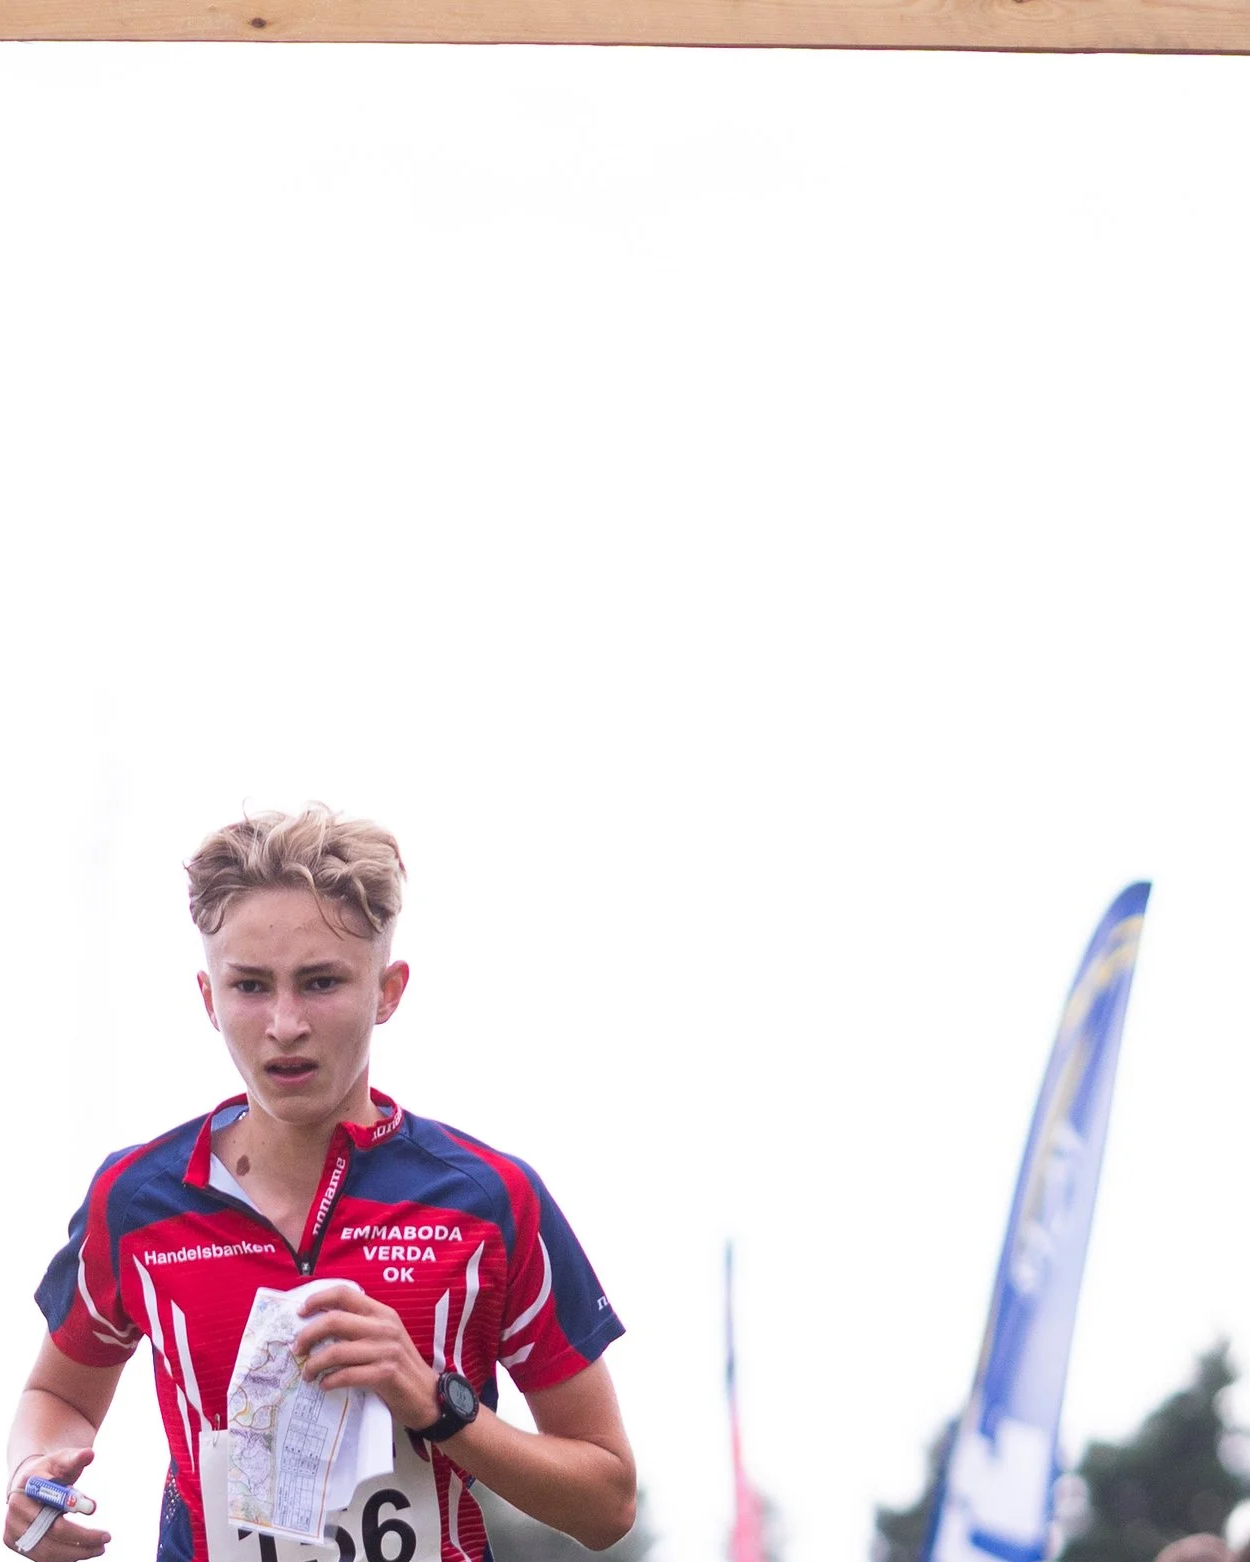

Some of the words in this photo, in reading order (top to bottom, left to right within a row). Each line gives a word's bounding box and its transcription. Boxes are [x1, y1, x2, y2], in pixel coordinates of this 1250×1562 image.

[312, 1157, 346, 1236] noname
[340, 1225, 462, 1242] EMMABODA
[144, 1240, 276, 1266] Handelsbanken
[363, 1246, 437, 1262] VERDA
[383, 1266, 415, 1283] OK
